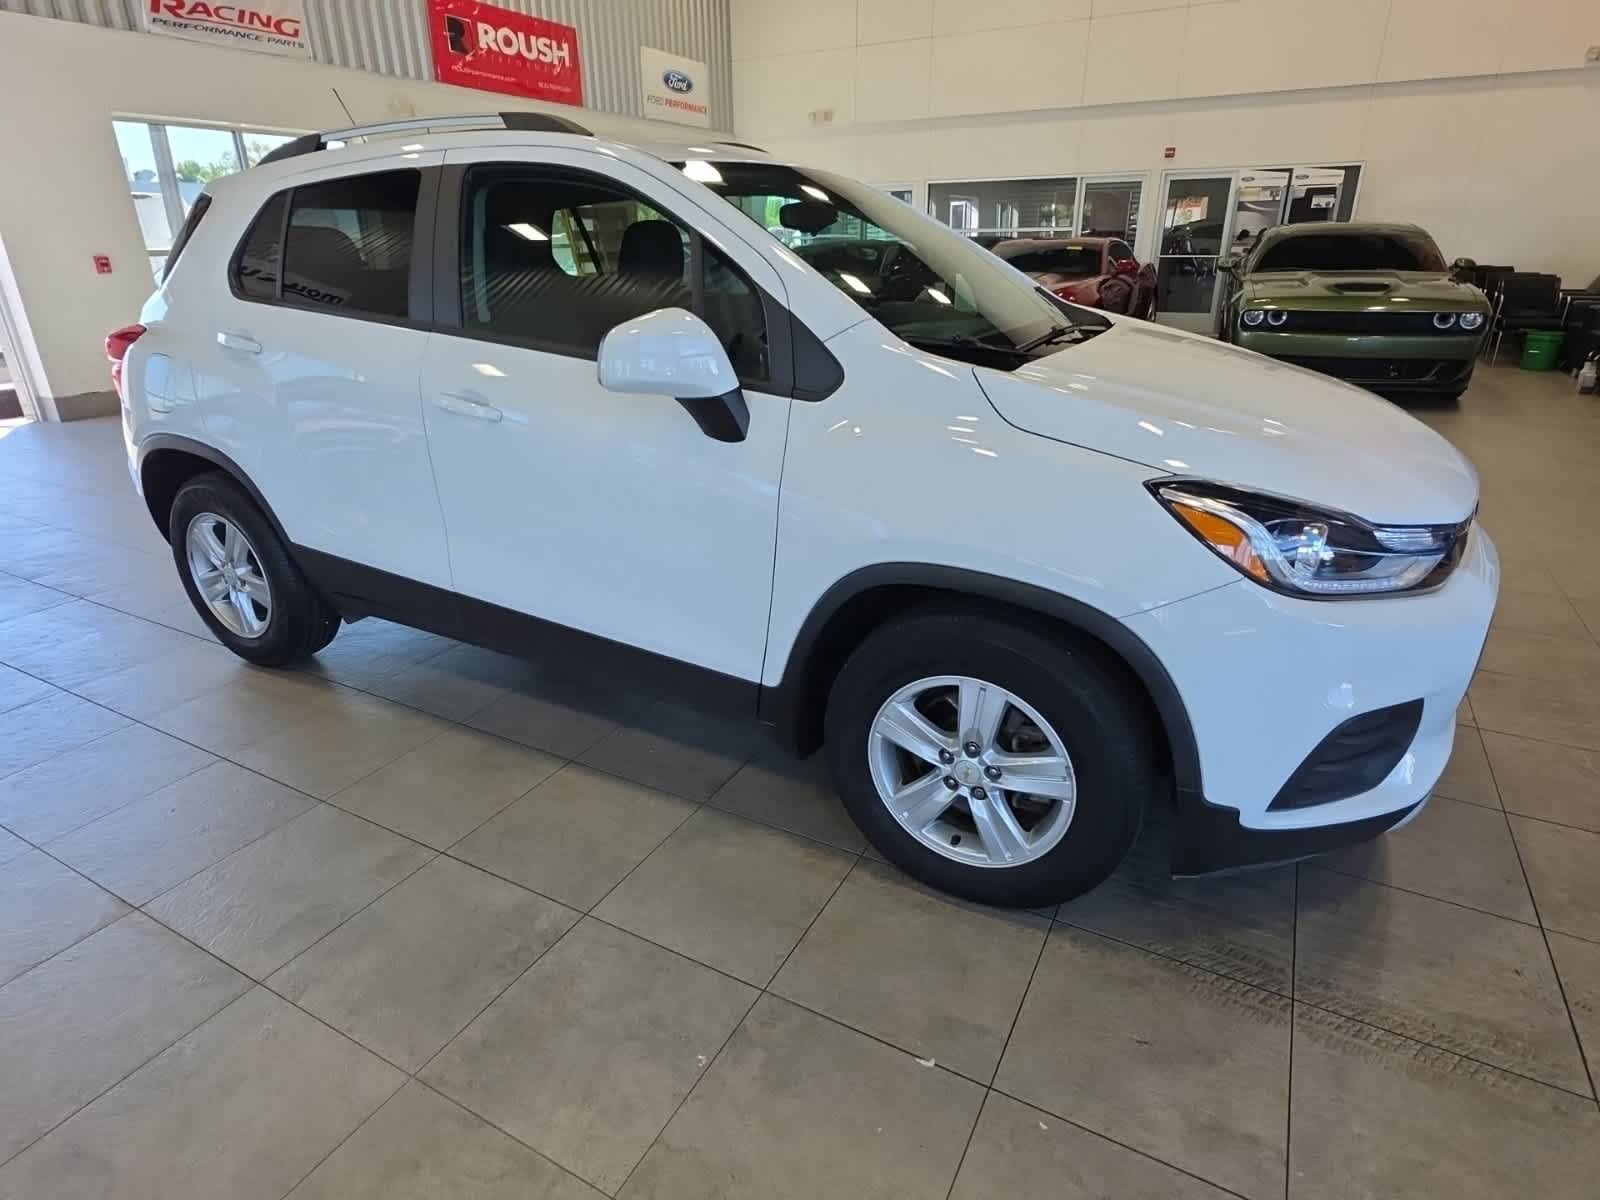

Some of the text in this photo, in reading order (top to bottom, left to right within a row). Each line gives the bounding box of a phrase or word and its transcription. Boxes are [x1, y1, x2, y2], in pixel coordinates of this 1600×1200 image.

[150, 0, 301, 38] RACING
[152, 17, 305, 48] PERFORMANCE PARTS
[477, 22, 569, 67] ROUSH
